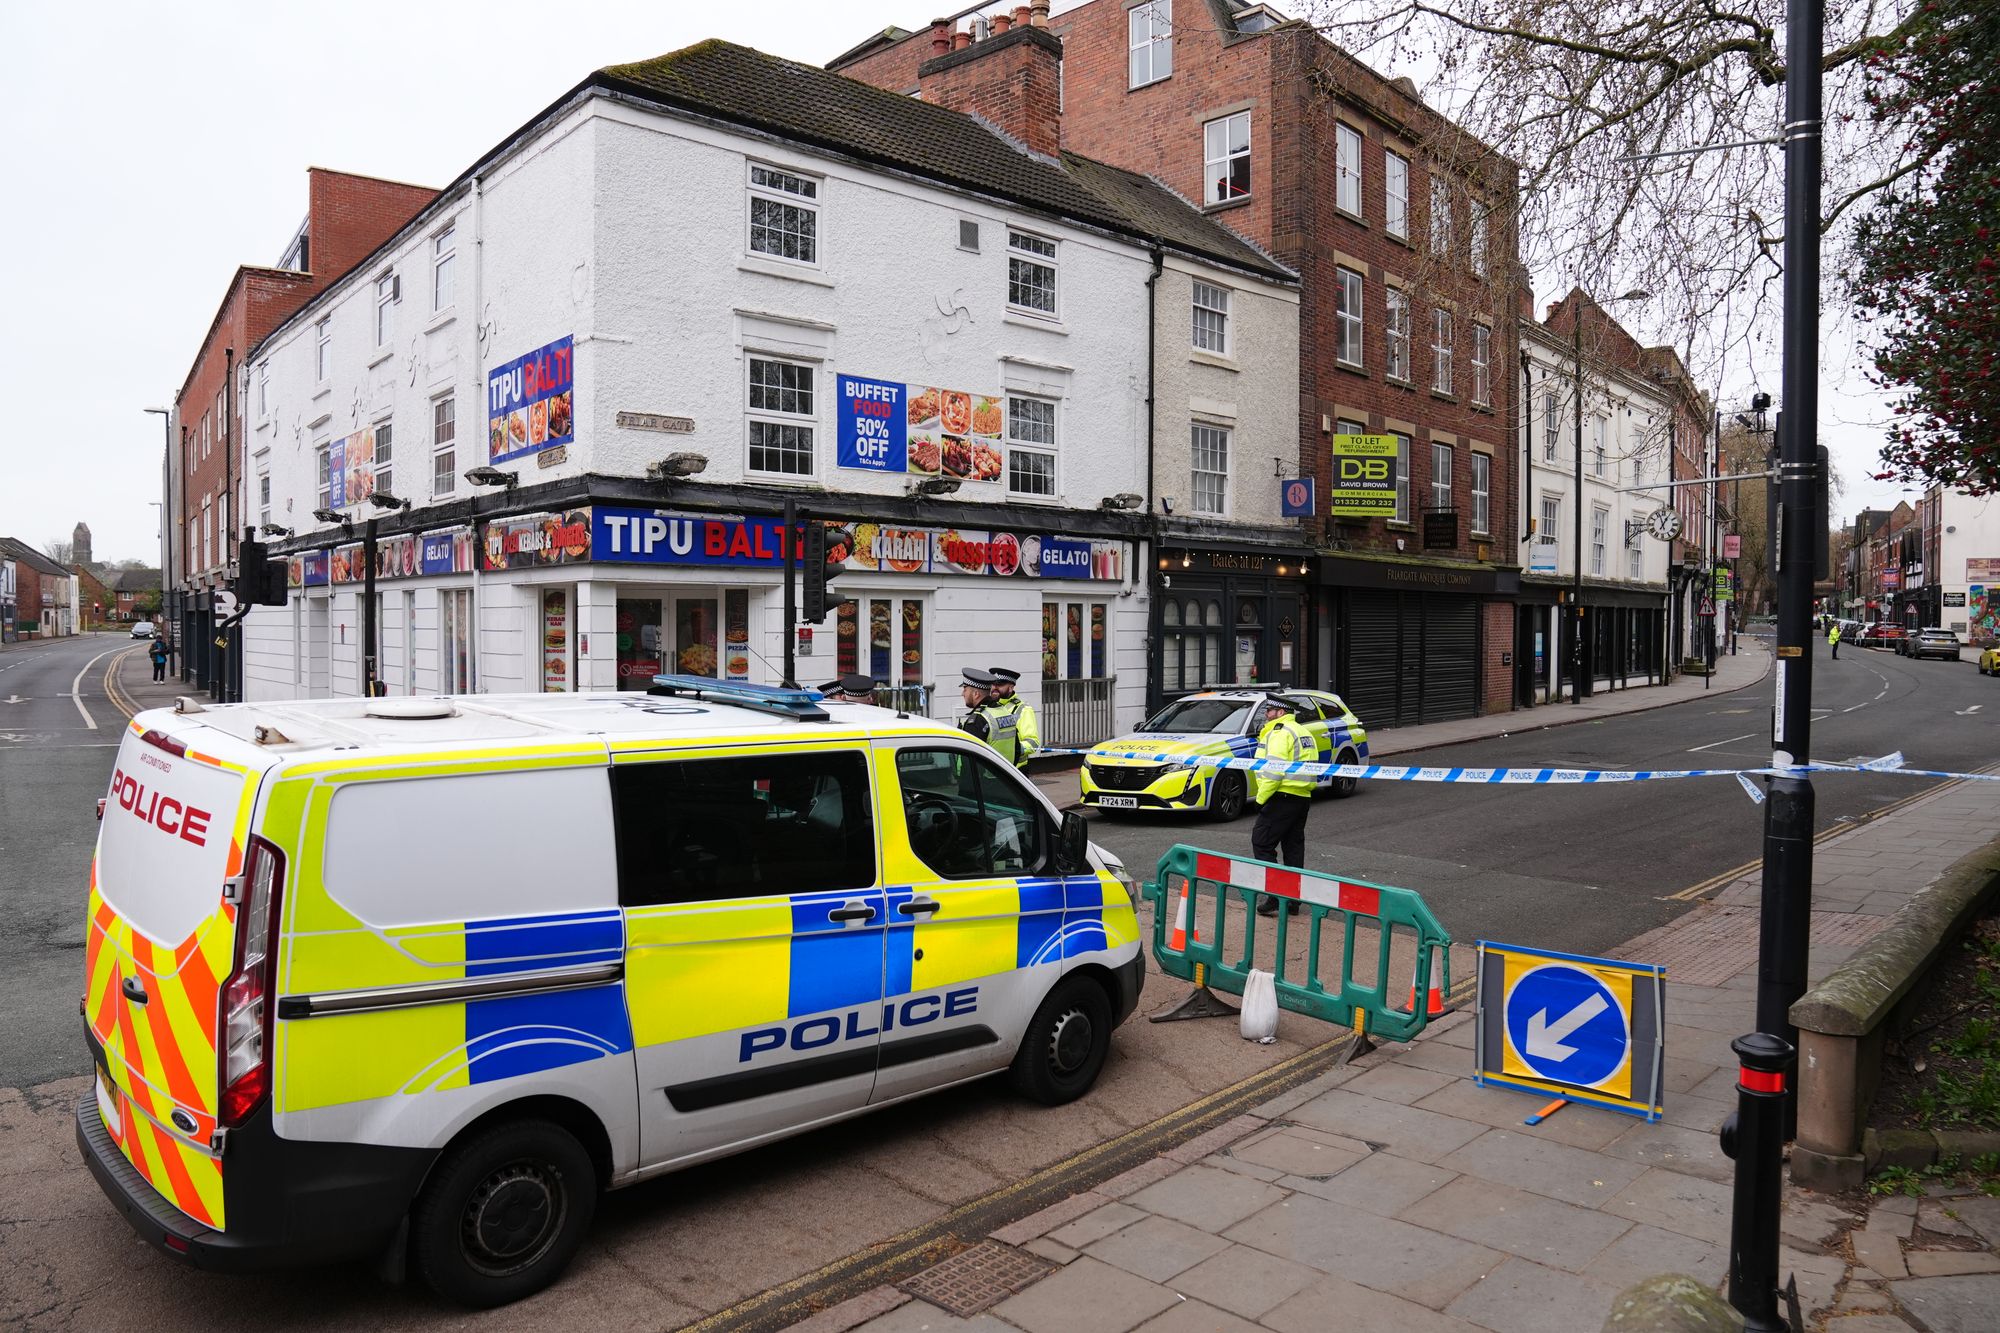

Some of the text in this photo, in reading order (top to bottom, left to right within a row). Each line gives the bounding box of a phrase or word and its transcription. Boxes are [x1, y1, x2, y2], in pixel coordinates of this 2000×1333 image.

[490, 346, 571, 411] TIPU BALTI
[845, 381, 898, 403] BUFFET
[853, 399, 891, 418] FOOD
[618, 415, 692, 432] FRIAR GATE
[856, 417, 889, 438] 50%
[856, 437, 889, 458] OFF
[1350, 436, 1381, 445] TO LET
[872, 459, 886, 467] Apply
[489, 535, 503, 555] TIPU
[519, 531, 544, 552] KEBABS
[545, 532, 551, 549] &
[551, 522, 587, 548] BURGERS
[604, 515, 692, 556] TIPU
[426, 543, 449, 561] GELATO
[871, 535, 1088, 566] KARAHI & DESSERTS GELATO
[1212, 554, 1238, 568] Bates
[1240, 557, 1249, 569] at
[145, 754, 172, 774] CONDITIONED
[1233, 760, 1250, 768] POLICE
[1268, 762, 1286, 771] POLICE
[1304, 764, 1323, 772] POLICE
[1342, 767, 1361, 775] POLICE
[1382, 768, 1401, 776] POLICE
[1422, 770, 1443, 779] POLICE
[1465, 771, 1487, 779] POLICE
[1510, 771, 1533, 780] POLICE
[1557, 772, 1581, 780] POLICE
[111, 767, 212, 848] POLICE
[1101, 797, 1135, 807] FY24 XRM
[739, 986, 979, 1063] POLICE
